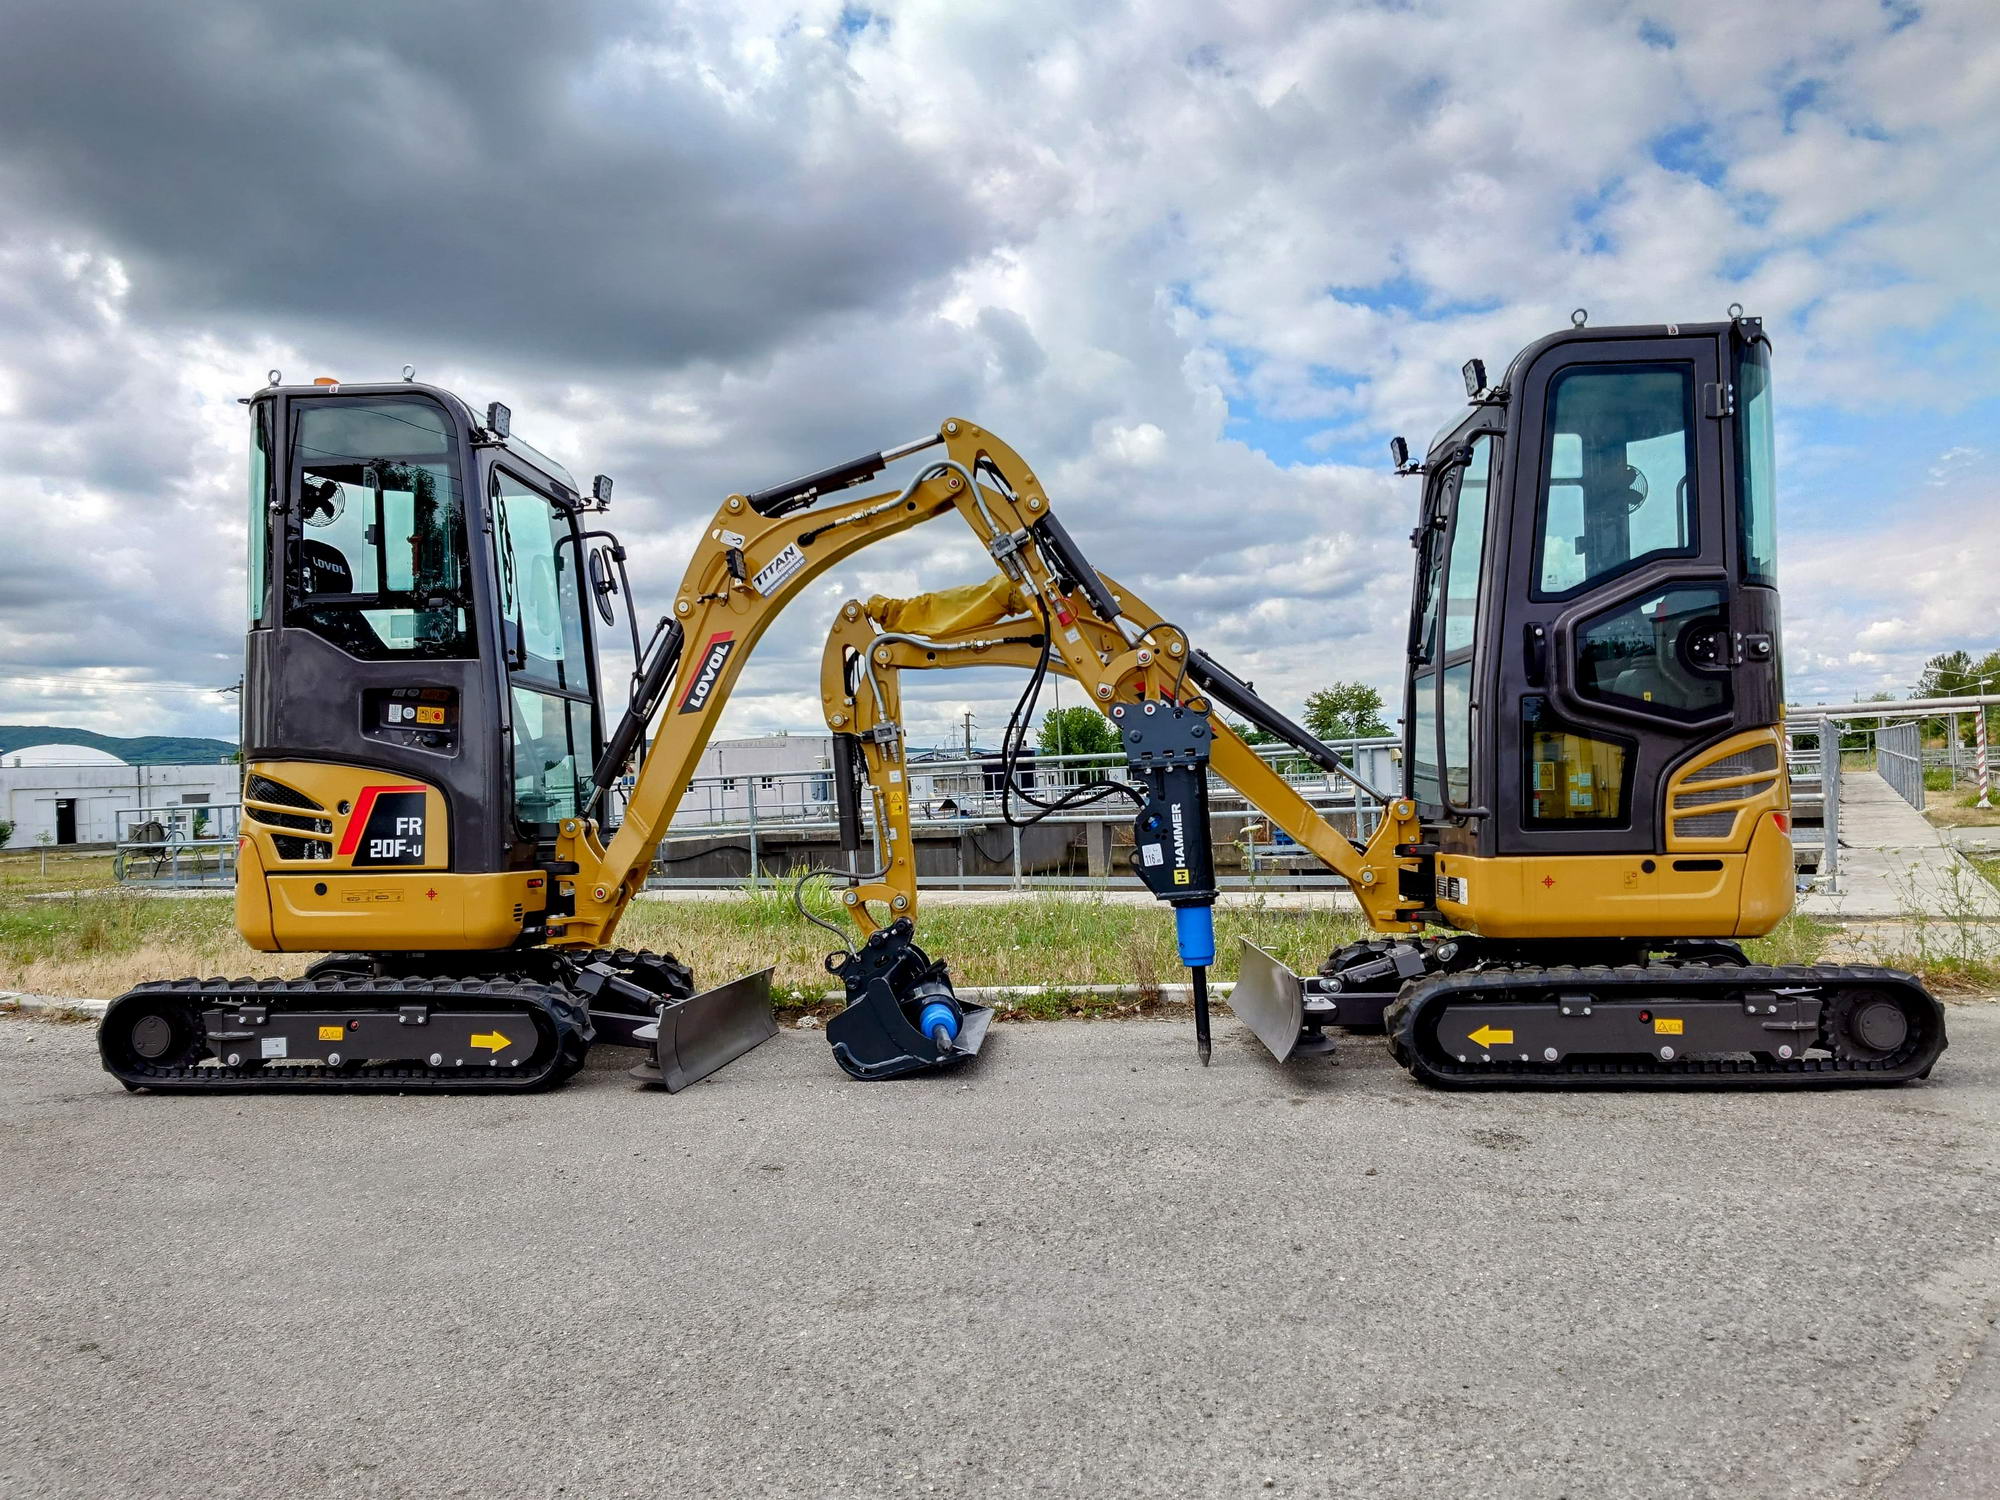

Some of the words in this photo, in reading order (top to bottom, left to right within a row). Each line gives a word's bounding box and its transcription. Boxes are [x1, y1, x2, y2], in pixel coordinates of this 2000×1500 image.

[312, 556, 346, 576] LOVOL
[753, 546, 795, 586] TITAN
[689, 644, 730, 708] LOVOL
[396, 817, 422, 836] FR
[1171, 803, 1185, 868] HAMMER
